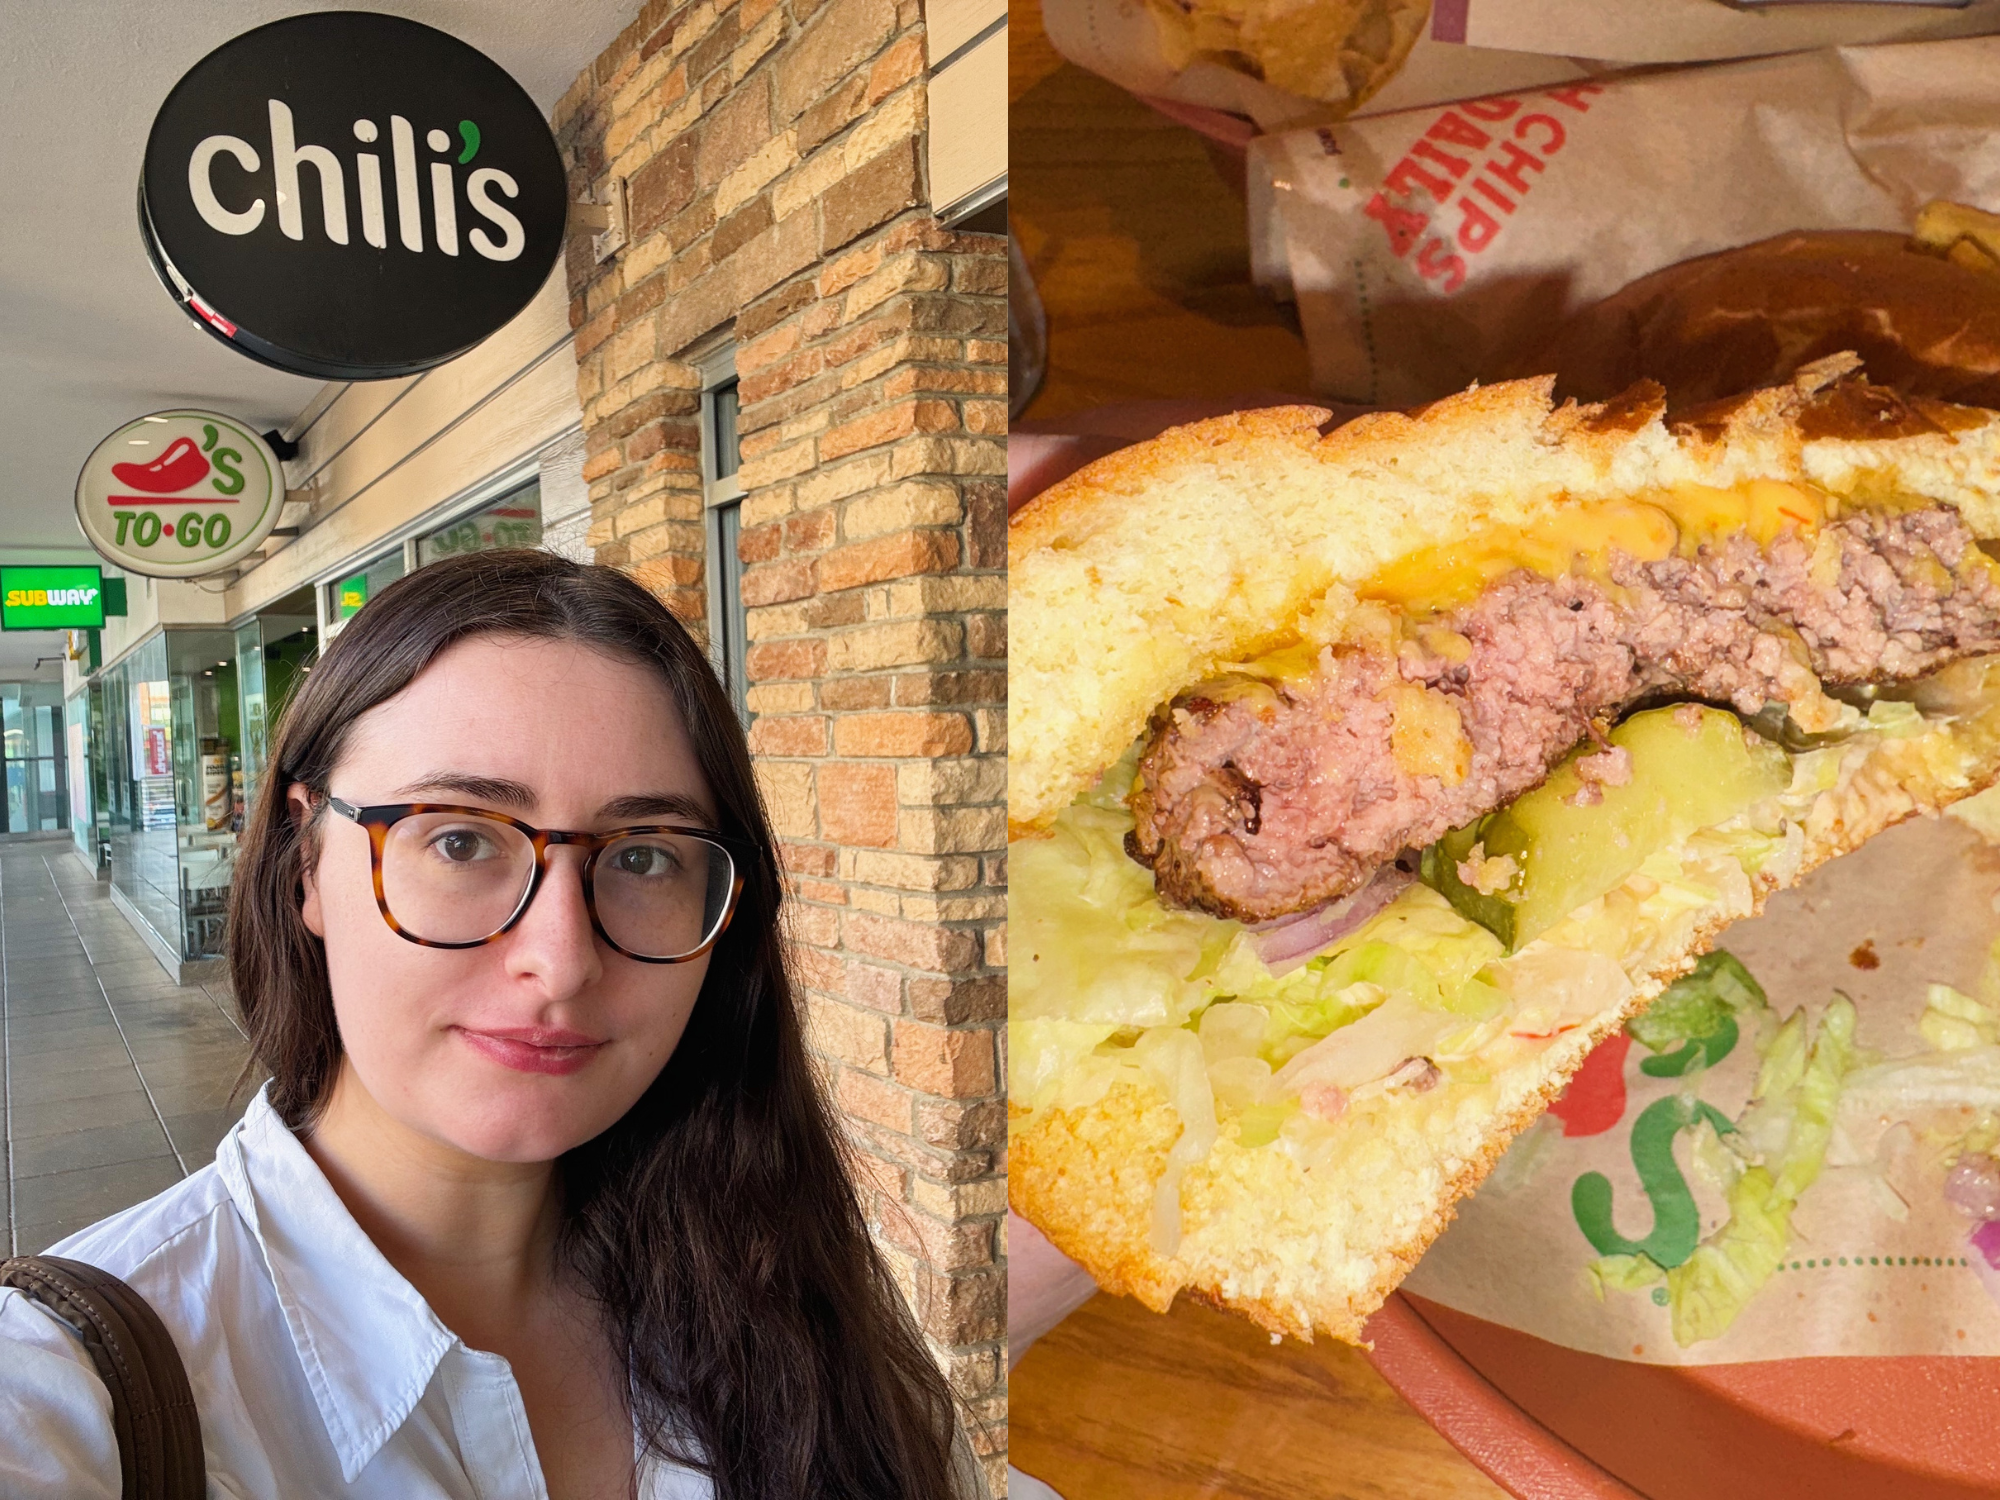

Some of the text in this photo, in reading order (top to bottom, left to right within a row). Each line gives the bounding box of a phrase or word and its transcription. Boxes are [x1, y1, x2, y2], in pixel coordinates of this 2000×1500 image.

[187, 98, 527, 263] chili's
[1415, 112, 1567, 295] CHIPS
[5, 588, 98, 607] SUBWAY
